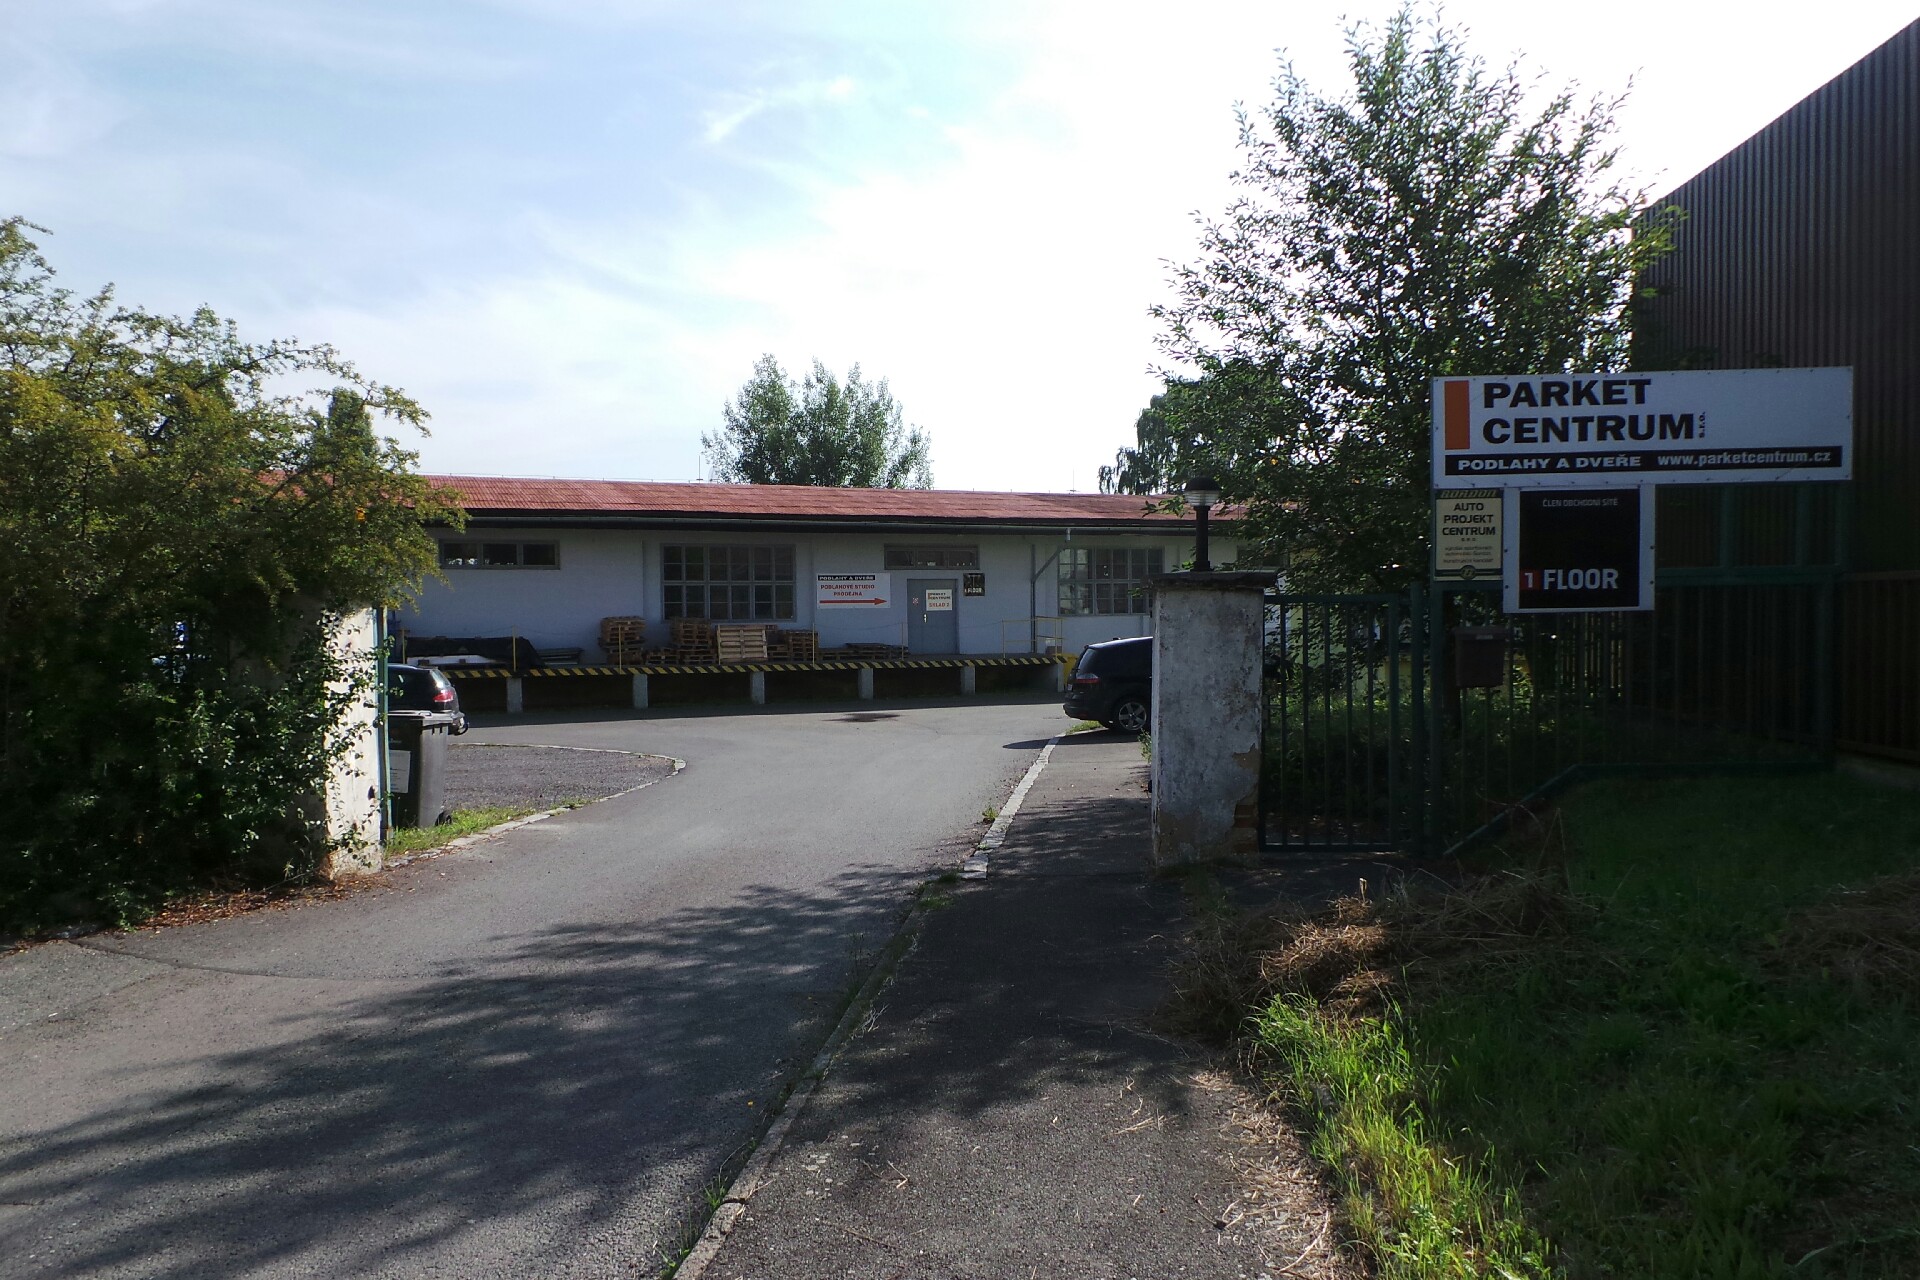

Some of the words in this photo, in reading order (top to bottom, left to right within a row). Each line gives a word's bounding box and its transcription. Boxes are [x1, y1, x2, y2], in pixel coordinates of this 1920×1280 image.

[1483, 379, 1651, 408] PARKET
[1483, 413, 1694, 444] CENTRUM
[1458, 457, 1551, 471] PODLAHY
[1556, 457, 1570, 469] A
[1575, 453, 1641, 469] DVEŘE
[1658, 452, 1831, 467] www.parketcentrum.cz
[1453, 502, 1484, 511] AUTO
[1443, 514, 1494, 524] PROJEKT
[1442, 526, 1496, 536] CENTRUM
[1524, 572, 1533, 588] 1
[1543, 569, 1618, 590] FLOOR
